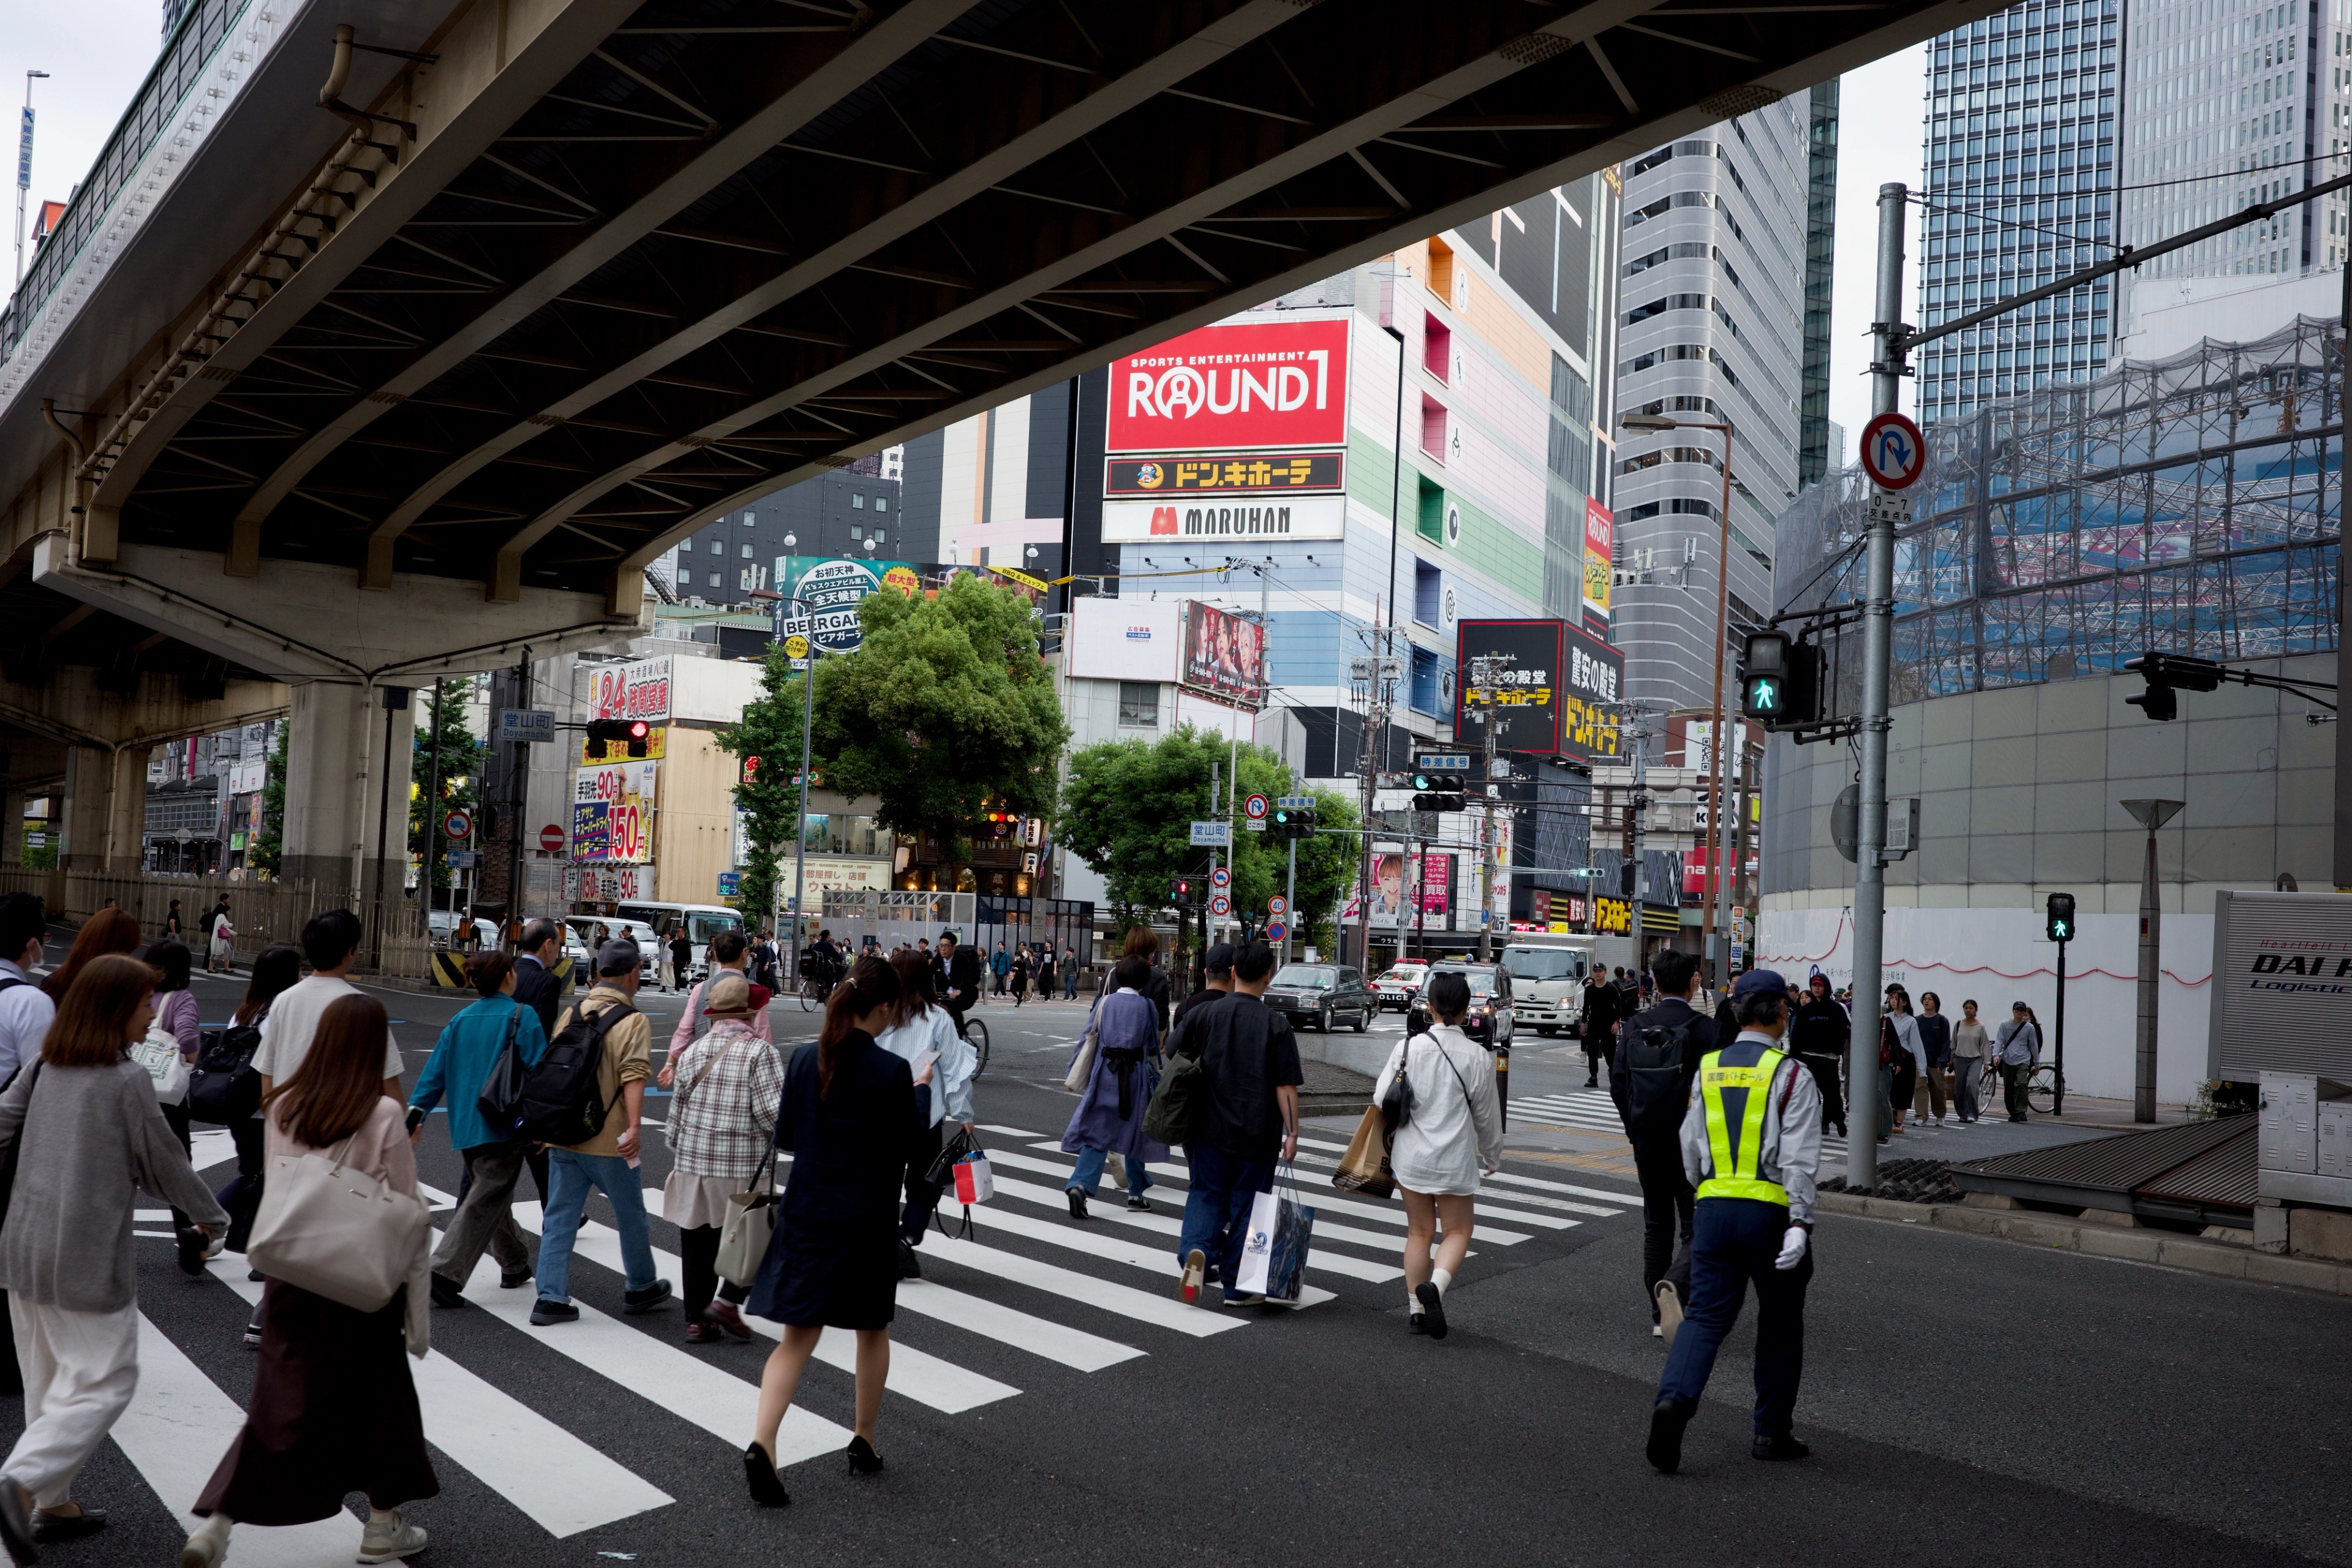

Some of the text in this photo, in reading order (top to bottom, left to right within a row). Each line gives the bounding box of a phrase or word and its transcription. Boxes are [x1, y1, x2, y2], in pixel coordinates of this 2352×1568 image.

[23, 124, 32, 145] 難波
[1131, 351, 1305, 368] SPORTS ENTERTAINMENT
[1128, 350, 1329, 420] ROUND1
[1185, 507, 1291, 535] MARUHAN
[1870, 508, 1912, 522] 交差点内
[815, 565, 854, 578] お初天神
[888, 573, 915, 587] 超大型
[1002, 568, 1016, 578] BBQ
[1022, 578, 1044, 590] ビュッフェ
[815, 589, 861, 606] 全天候型
[1571, 645, 1617, 703] 驚安の殿堂
[504, 713, 550, 729] 堂山町
[503, 728, 550, 739] Doyamacho
[643, 764, 654, 774] Asahi
[1422, 757, 1468, 767] 時差信号
[578, 780, 597, 800] 手羽先
[1279, 798, 1315, 807] 時差信号
[581, 806, 594, 821] アサヒ
[580, 815, 608, 835] スーパードライ
[1194, 825, 1226, 837] 堂山町
[848, 872, 866, 881] 店舗
[601, 880, 618, 899] 手羽先
[720, 884, 729, 895] 空
[1273, 902, 1283, 910] 40
[2260, 940, 2332, 951] Heartfelt
[2251, 954, 2325, 975] DAI
[1707, 1072, 1765, 1083] 国際パトロール
